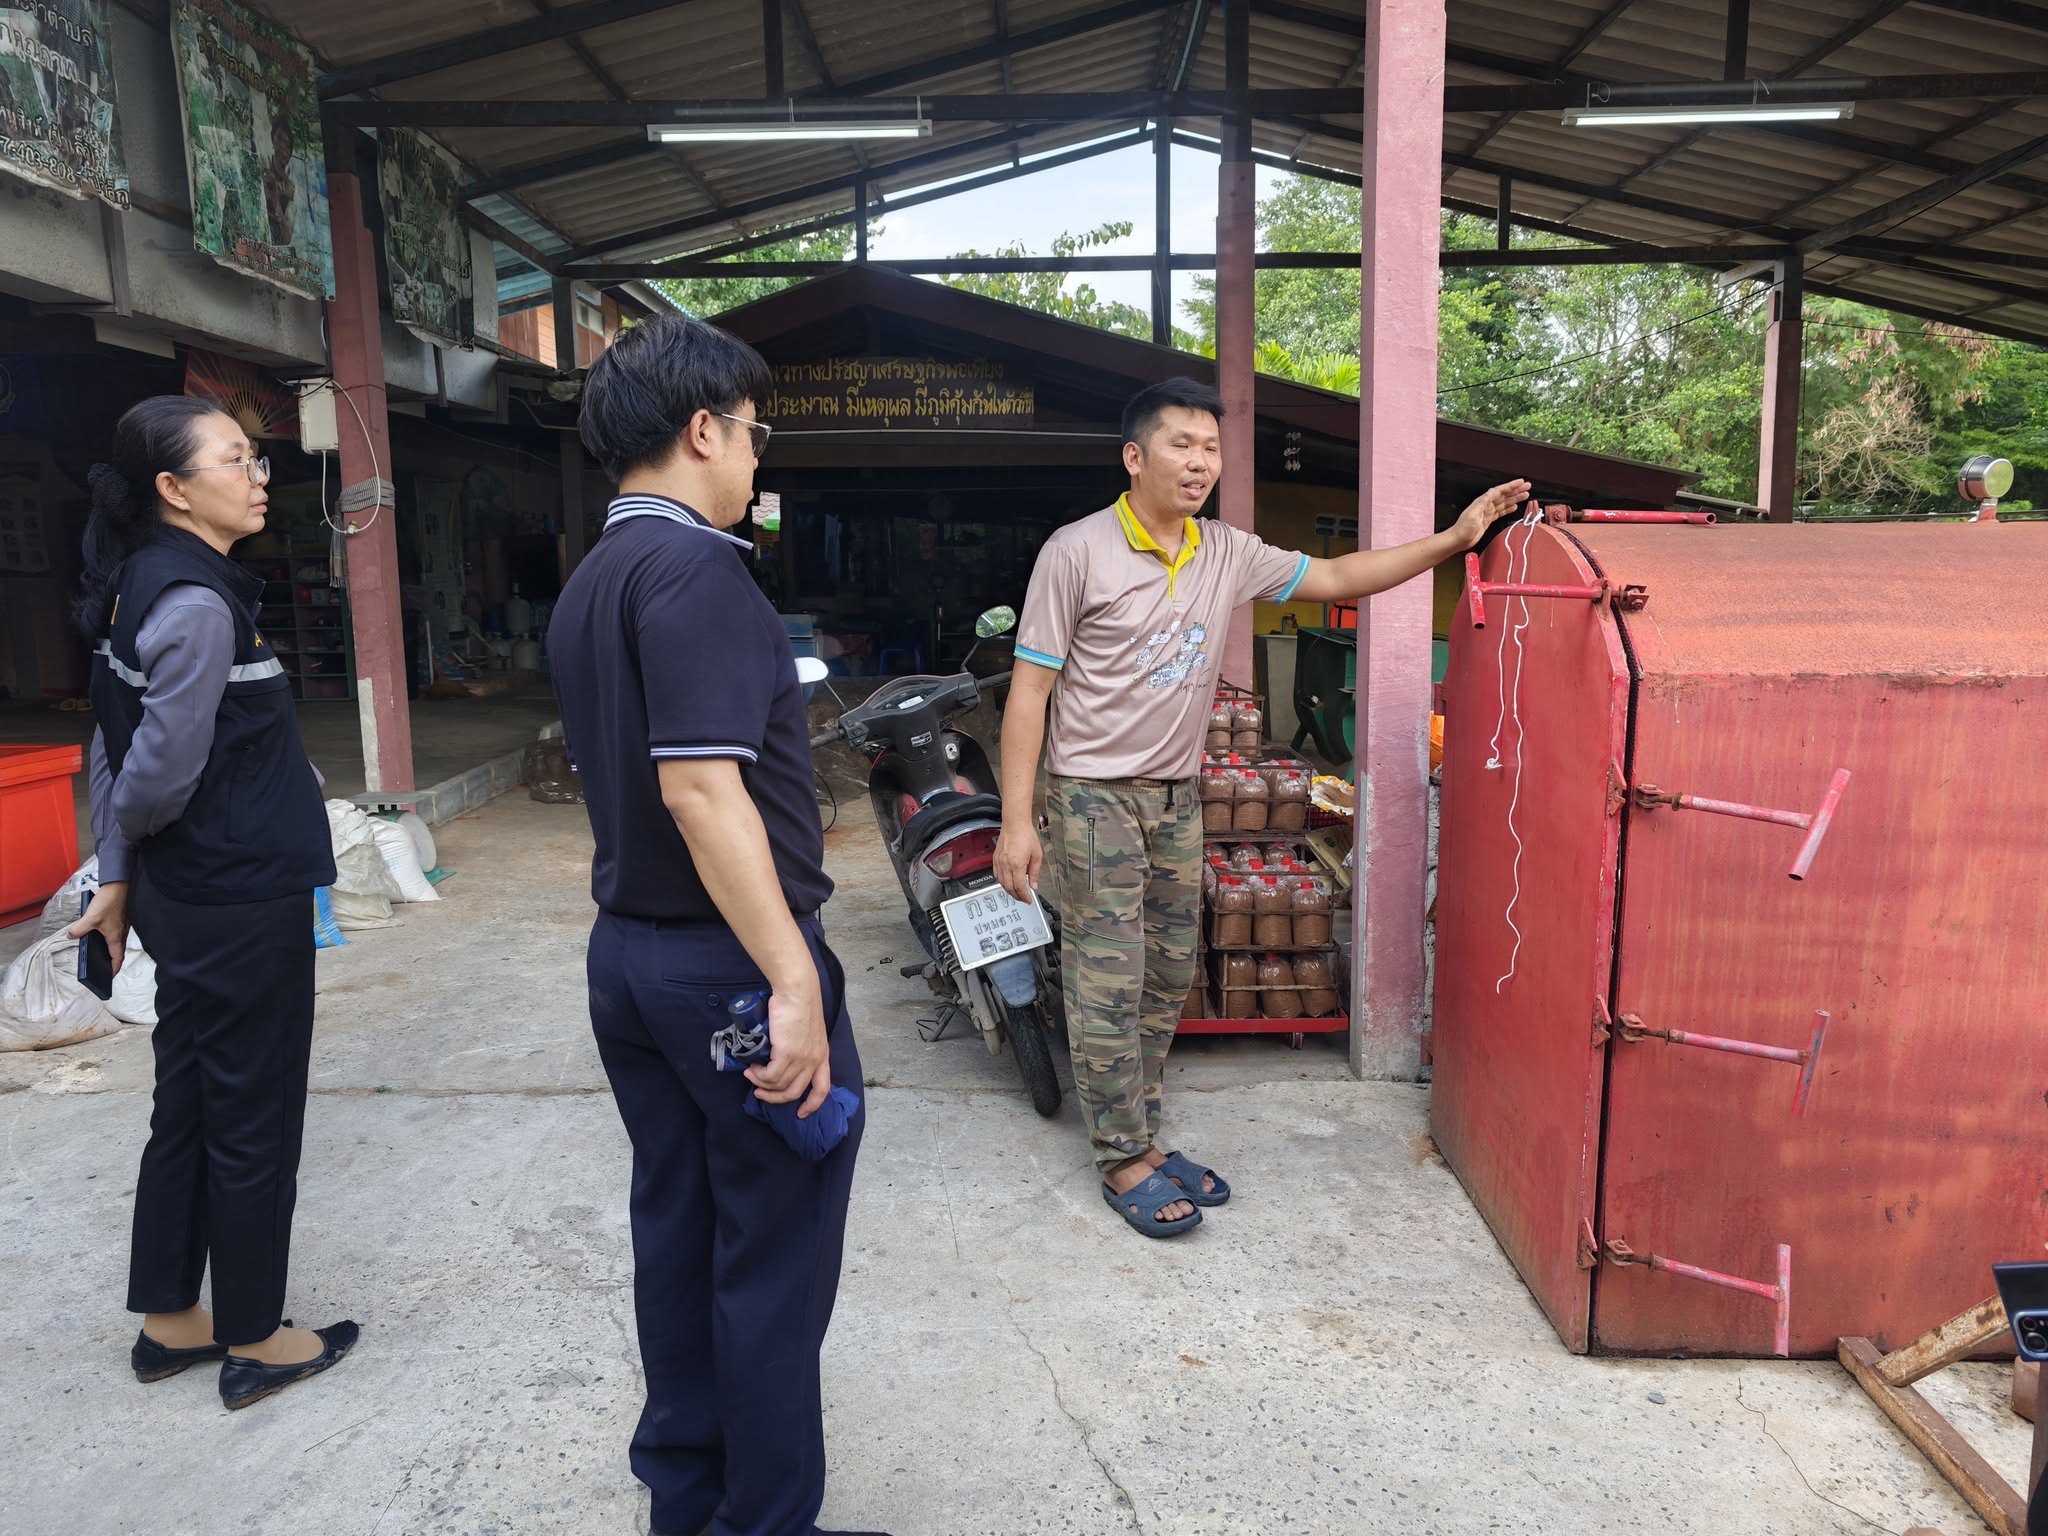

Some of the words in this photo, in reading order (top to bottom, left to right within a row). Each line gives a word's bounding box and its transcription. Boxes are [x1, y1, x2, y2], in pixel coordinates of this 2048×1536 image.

[763, 389, 839, 418] ประมาณ
[974, 909, 1022, 935] ปทุมธานี
